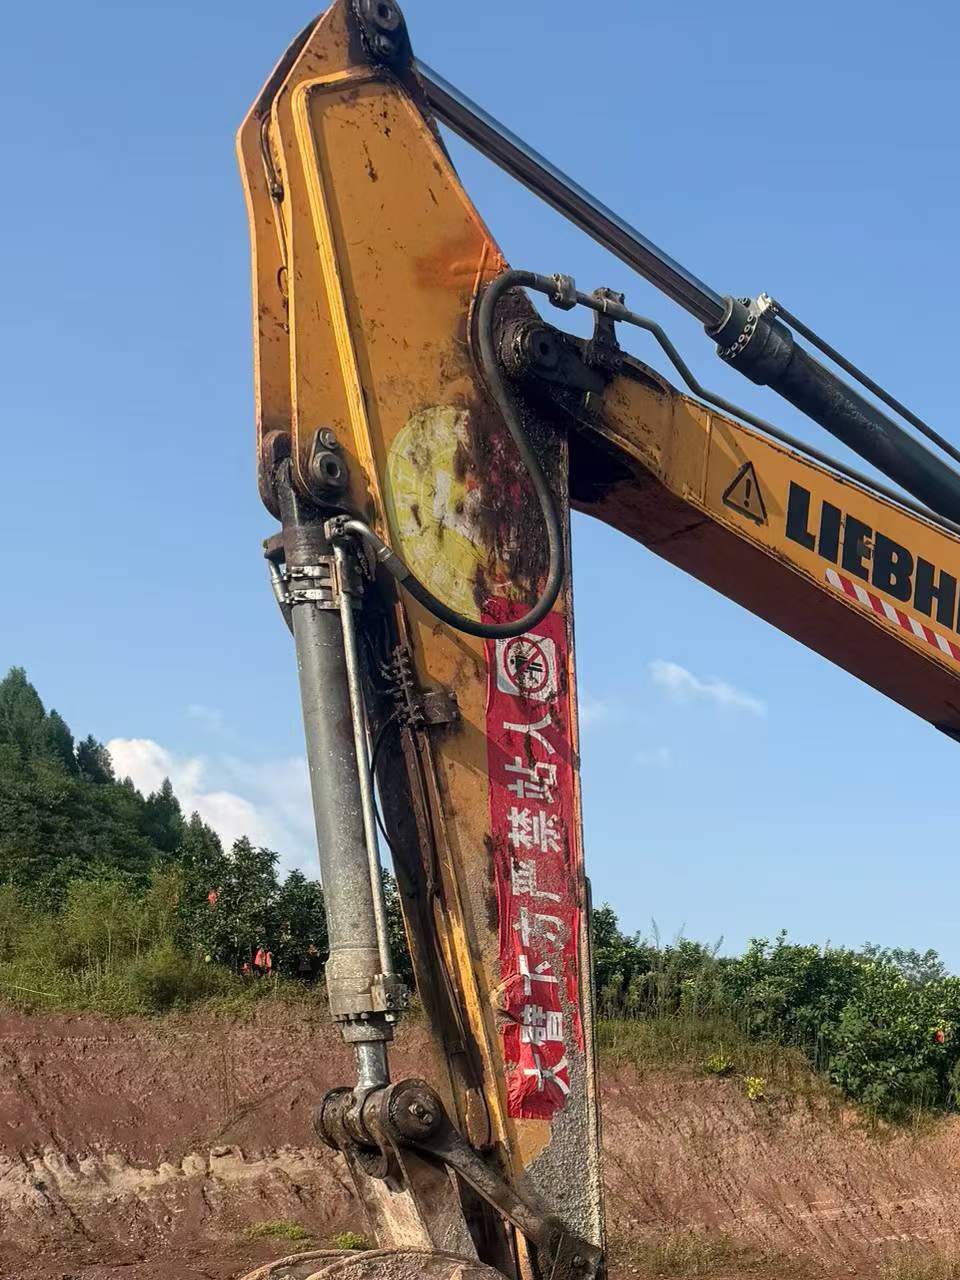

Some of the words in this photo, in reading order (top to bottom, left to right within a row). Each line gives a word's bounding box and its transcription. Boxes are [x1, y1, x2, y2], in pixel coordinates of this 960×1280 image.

[502, 712, 572, 1101] 大臂下方严禁站人
